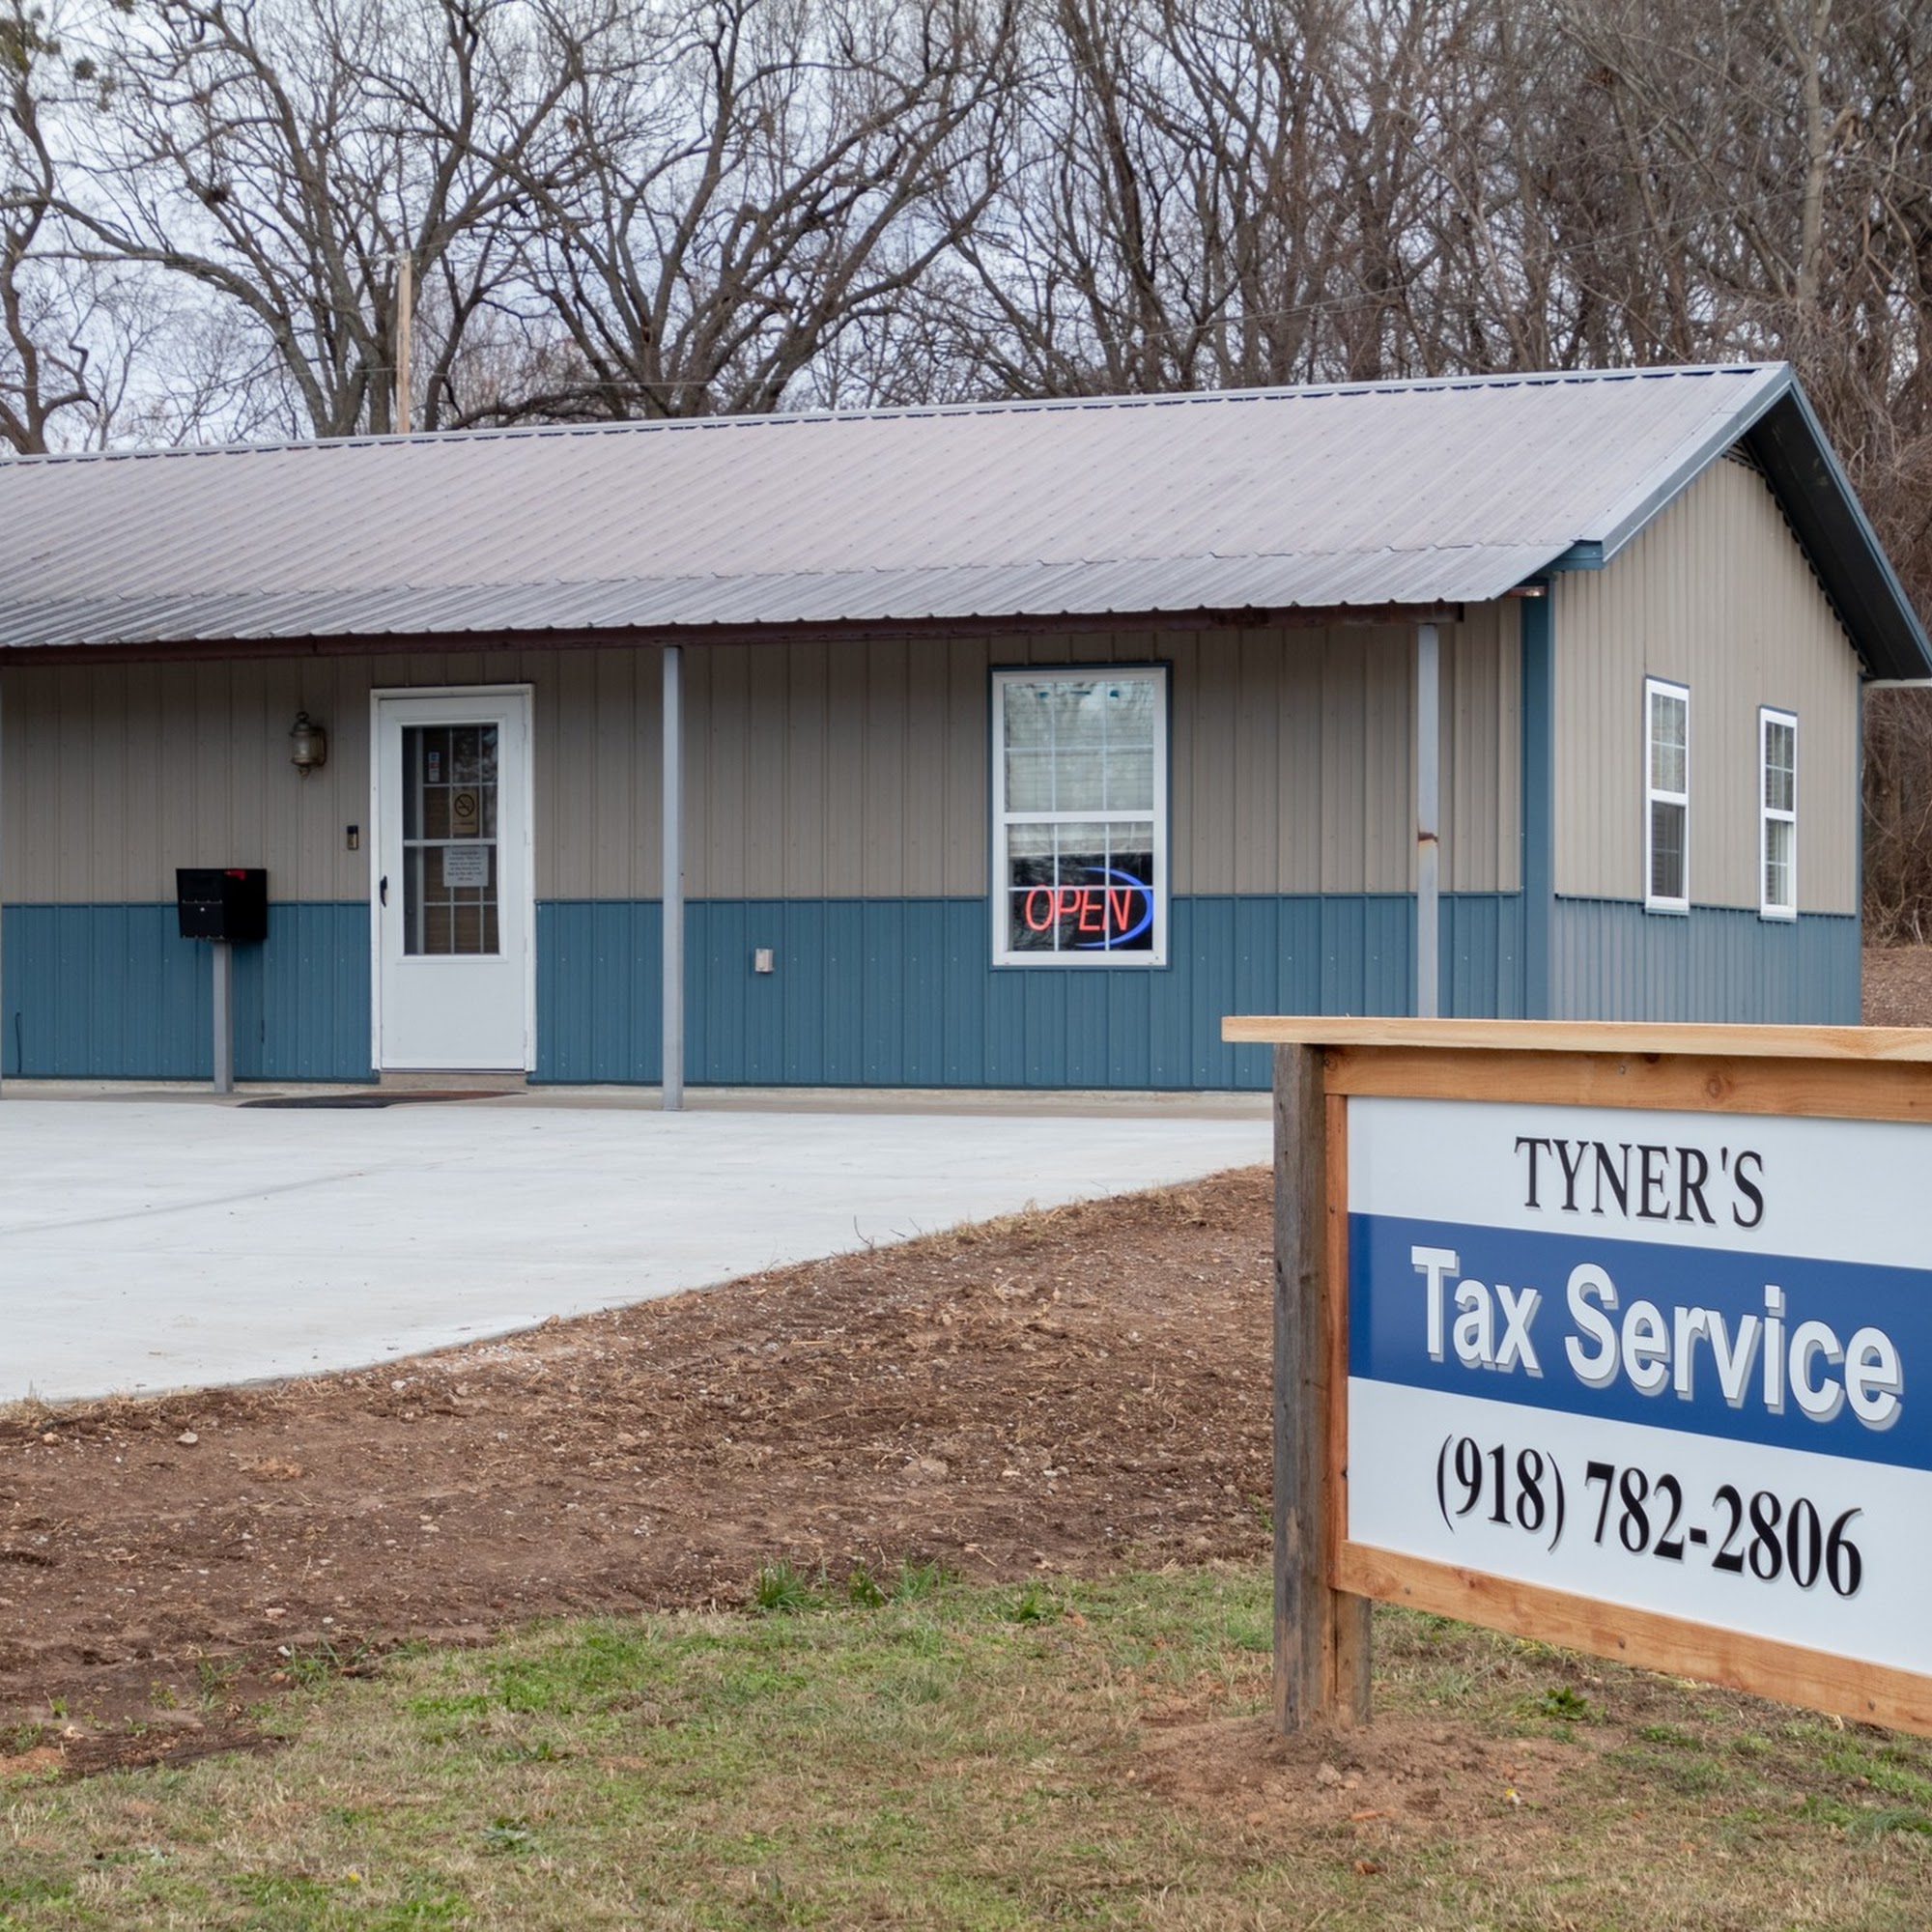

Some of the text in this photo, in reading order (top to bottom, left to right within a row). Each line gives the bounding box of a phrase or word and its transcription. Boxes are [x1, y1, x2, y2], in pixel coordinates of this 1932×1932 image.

[1025, 884, 1132, 931] OPEN
[1514, 1136, 1765, 1229] TYNER'S
[1410, 1245, 1902, 1430] Tax Service
[1436, 1434, 1864, 1599] (918) 782-2806
